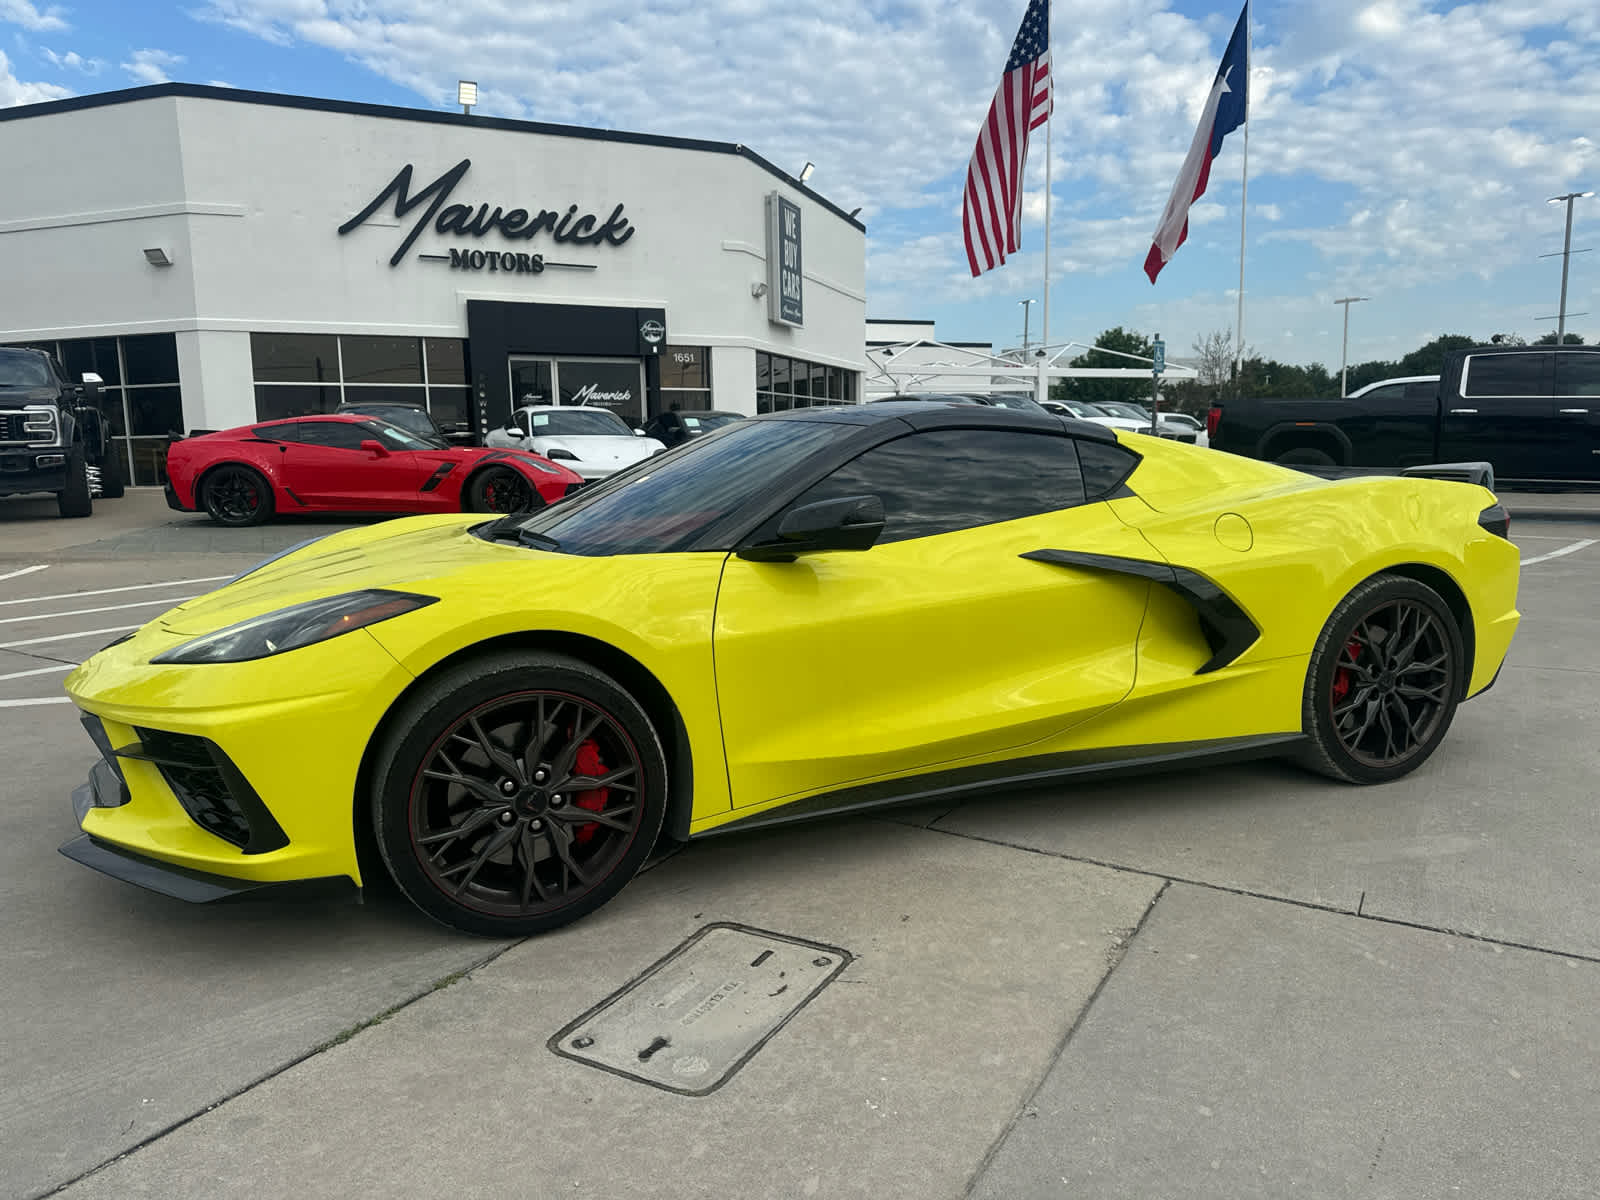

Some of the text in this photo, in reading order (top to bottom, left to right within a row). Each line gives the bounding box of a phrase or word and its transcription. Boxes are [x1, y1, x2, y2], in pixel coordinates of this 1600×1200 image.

[338, 158, 635, 267] Maverick
[784, 207, 797, 239] WE
[449, 248, 545, 273] MOTORS
[784, 239, 798, 271] BUY
[782, 269, 800, 301] CARS
[672, 352, 695, 363] 1651
[571, 383, 632, 407] Maverick
